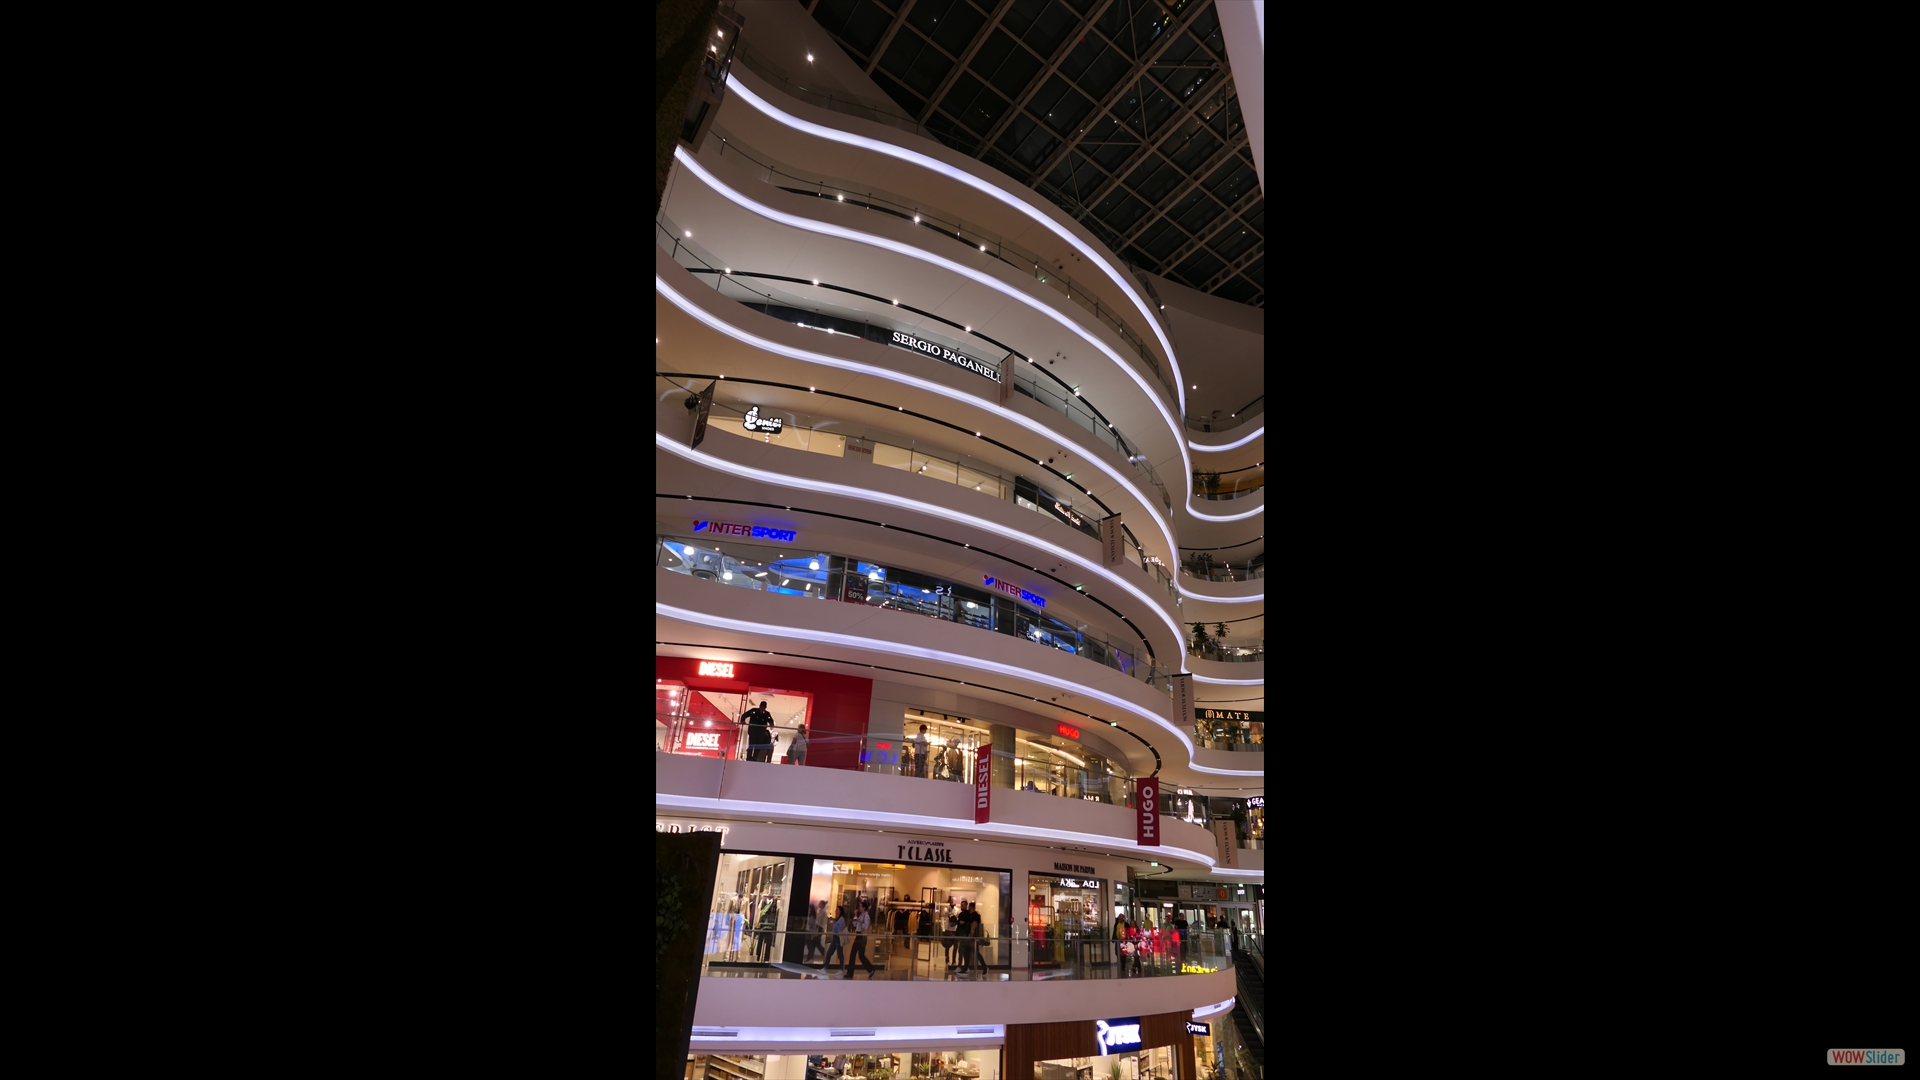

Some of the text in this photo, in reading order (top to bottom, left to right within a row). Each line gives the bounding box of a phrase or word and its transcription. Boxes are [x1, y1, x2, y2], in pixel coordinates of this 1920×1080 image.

[892, 331, 941, 356] SERGIO
[709, 521, 797, 542] INTERSPORT
[848, 590, 864, 600] 50%
[994, 578, 1046, 608] INTERSPORT
[699, 661, 734, 678] DIESEL
[1216, 711, 1249, 720] MATE
[686, 732, 719, 747] DIESEL
[1058, 724, 1080, 739] HUGO
[978, 754, 989, 809] DIESEL
[1142, 786, 1154, 838] HUGO
[908, 846, 953, 863] CLASSE
[1054, 862, 1073, 872] MAISON
[1106, 1024, 1141, 1046] JYSK
[1190, 1024, 1207, 1033] JYSK
